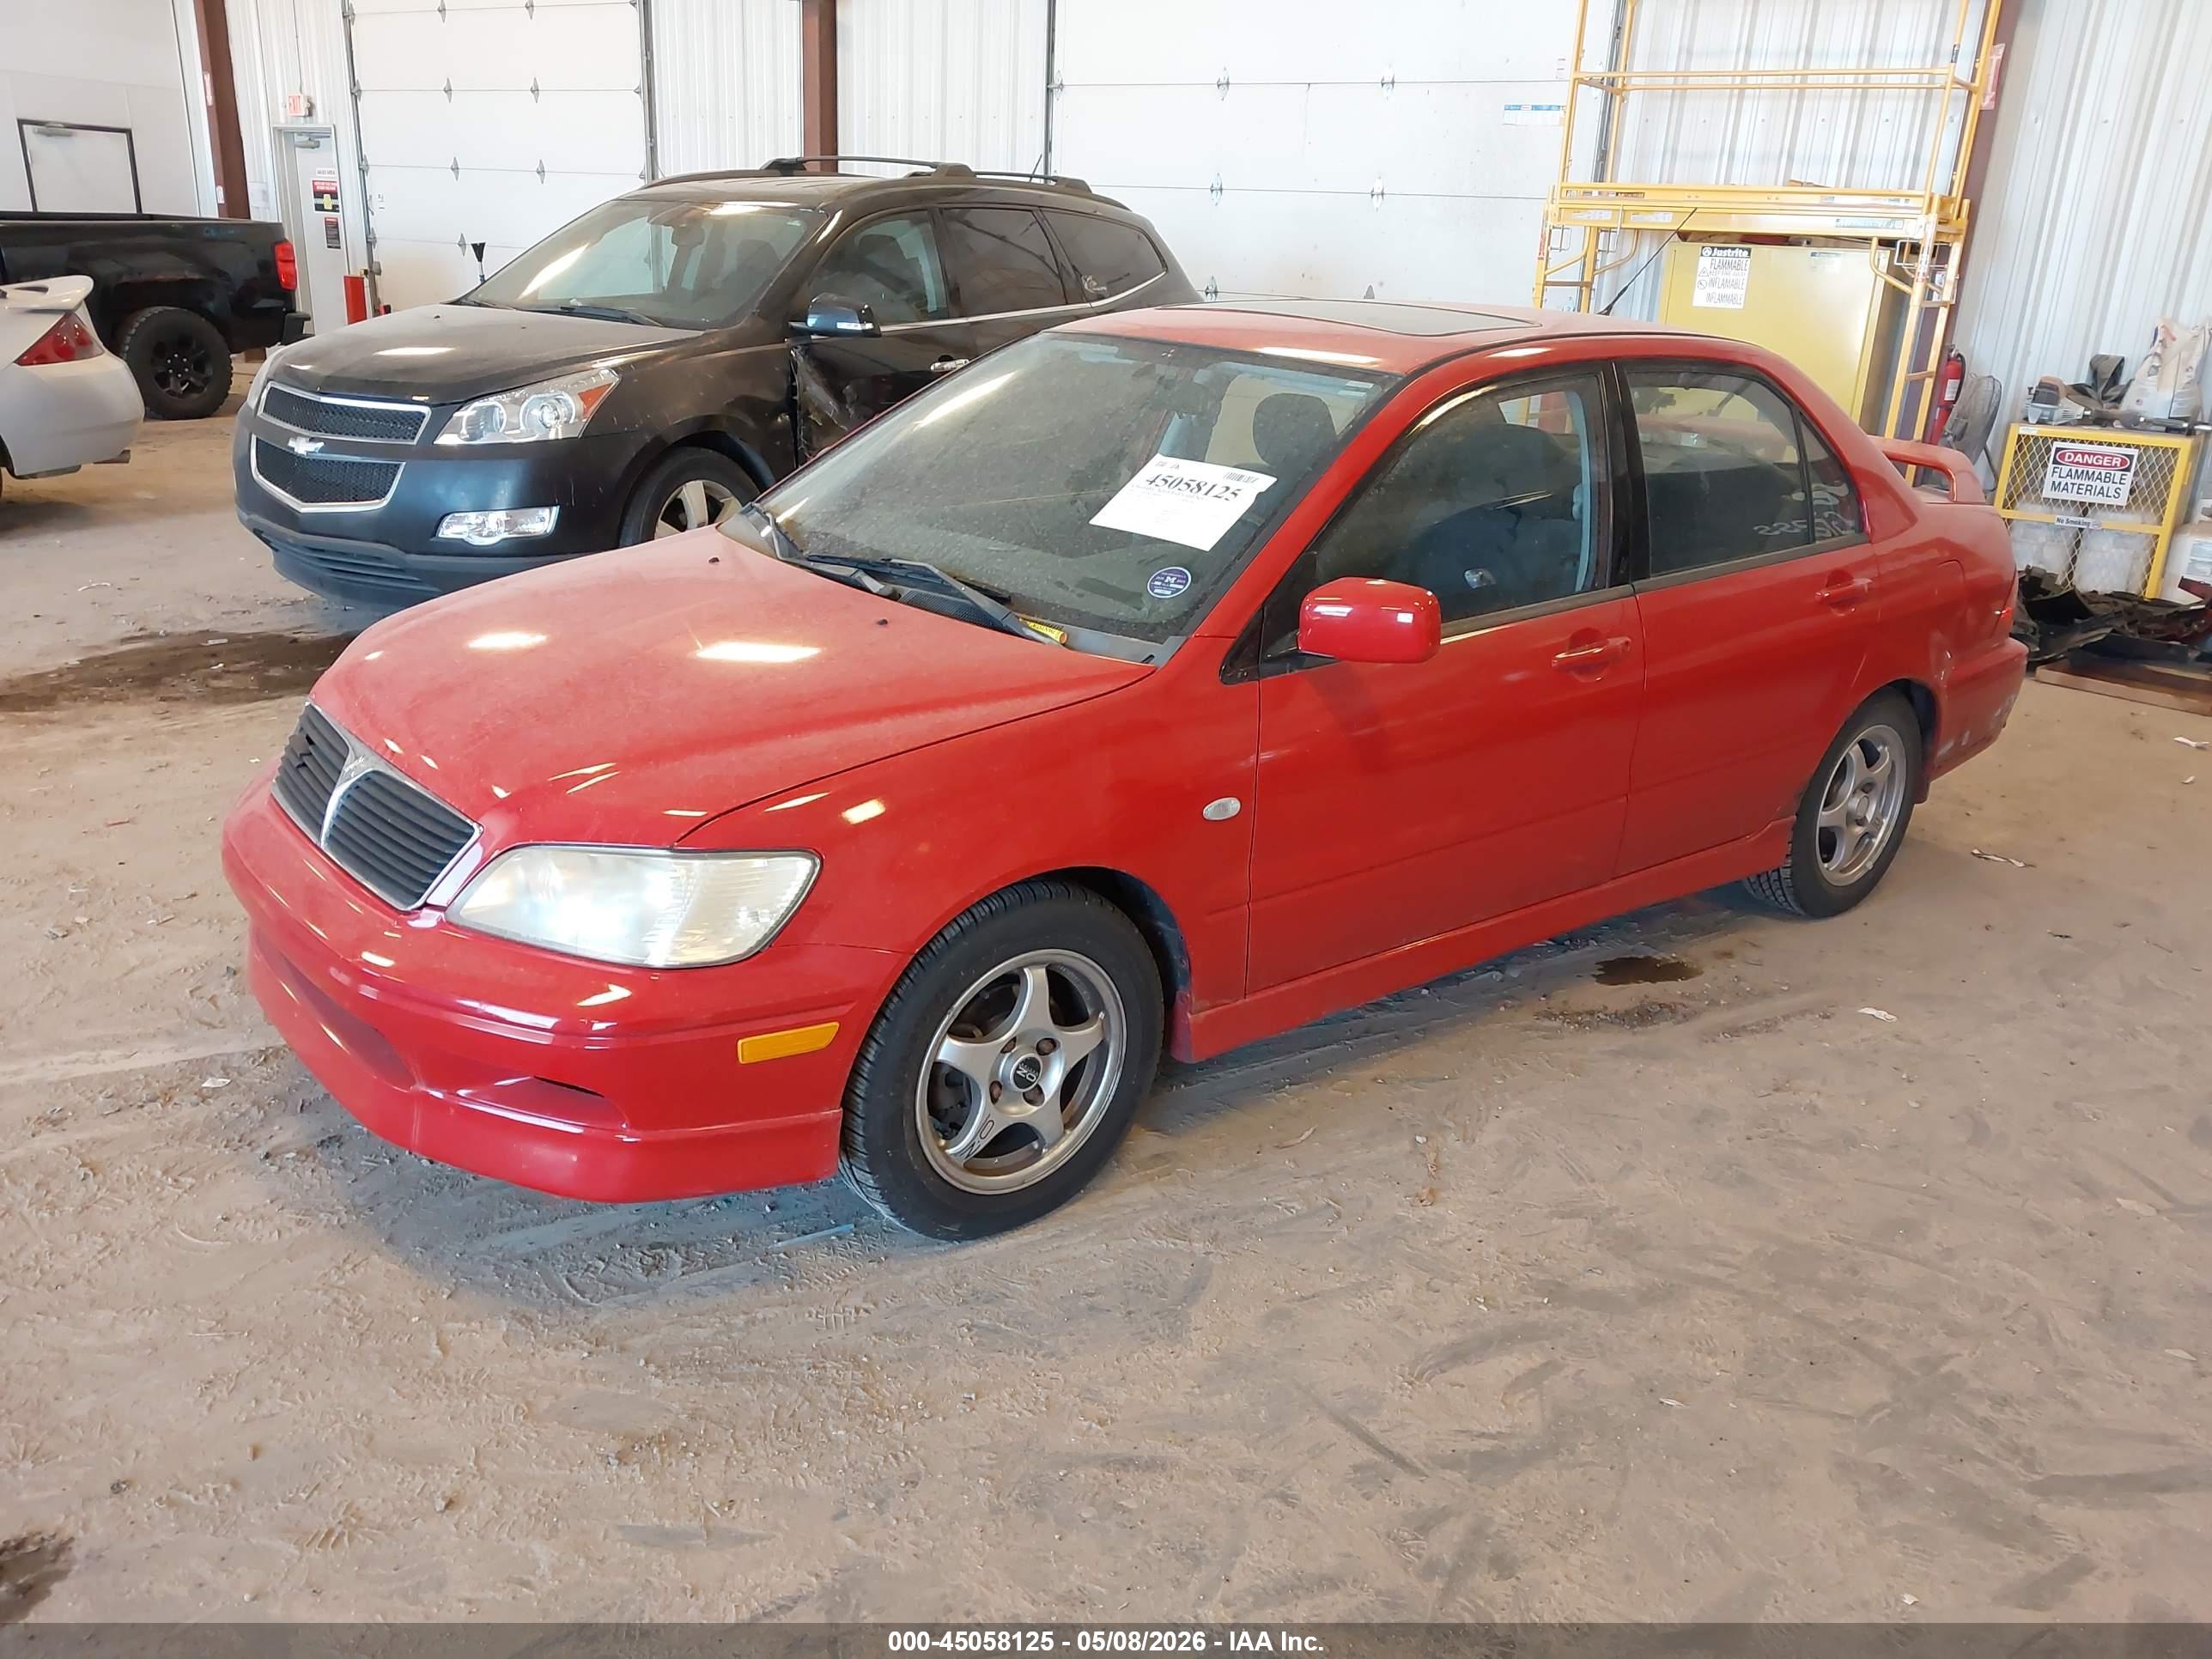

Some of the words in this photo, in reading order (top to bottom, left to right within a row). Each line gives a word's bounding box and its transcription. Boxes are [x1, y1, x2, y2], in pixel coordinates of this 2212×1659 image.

[1712, 247, 1749, 257] Justrite
[1711, 258, 1748, 271] FLAMMABLE
[2064, 452, 2122, 467] DANGER
[2051, 466, 2128, 485] FLAMMABLE
[1146, 473, 1243, 501] 45058125
[2051, 481, 2122, 499] MATERIALS
[2065, 518, 2092, 528] Smoking
